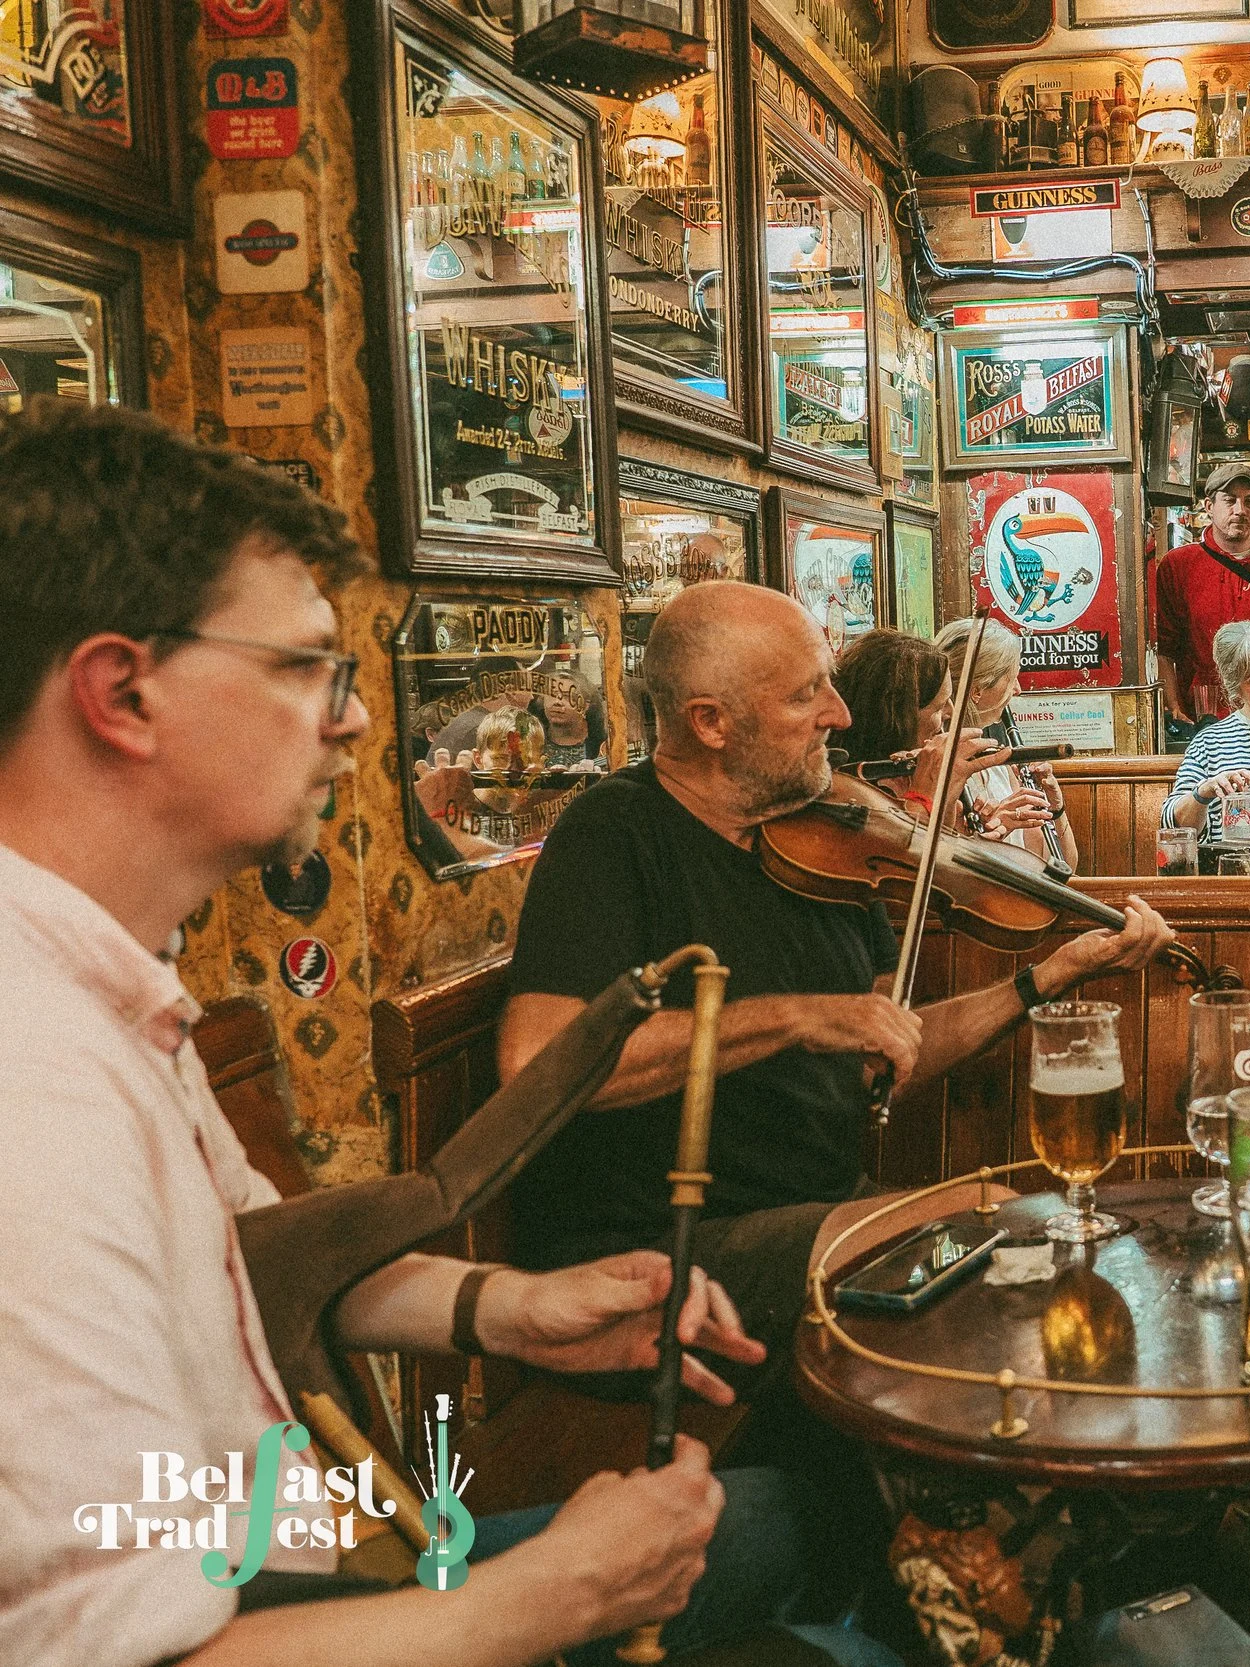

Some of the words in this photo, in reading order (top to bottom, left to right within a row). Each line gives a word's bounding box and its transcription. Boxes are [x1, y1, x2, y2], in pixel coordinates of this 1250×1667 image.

[1039, 81, 1062, 89] GOOD
[1192, 161, 1223, 178] Bass
[993, 186, 1098, 210] GUINNESS
[605, 199, 692, 284] WHISKY
[610, 275, 701, 334] ONDONDERRY.
[441, 317, 567, 415] WHISKY
[1049, 357, 1098, 397] BELFAST
[456, 420, 495, 449] Awarded
[495, 428, 510, 451] 24
[970, 400, 1024, 442] ROYAL
[1025, 415, 1066, 435] POTASS
[1067, 413, 1102, 433] WATER
[541, 514, 578, 531] BELFAST
[472, 607, 549, 648] PADDY
[1020, 632, 1099, 654] INNESS
[1021, 656, 1048, 667] ood
[1050, 654, 1071, 666] for
[1073, 655, 1099, 669] you
[437, 682, 482, 726] CORK
[482, 671, 564, 702] DISTILLERIES
[1012, 711, 1055, 722] GUINNESS
[1060, 711, 1085, 720] Cellar
[1087, 710, 1105, 719] Cool
[444, 800, 481, 836] OLD
[488, 813, 533, 839] IRISH
